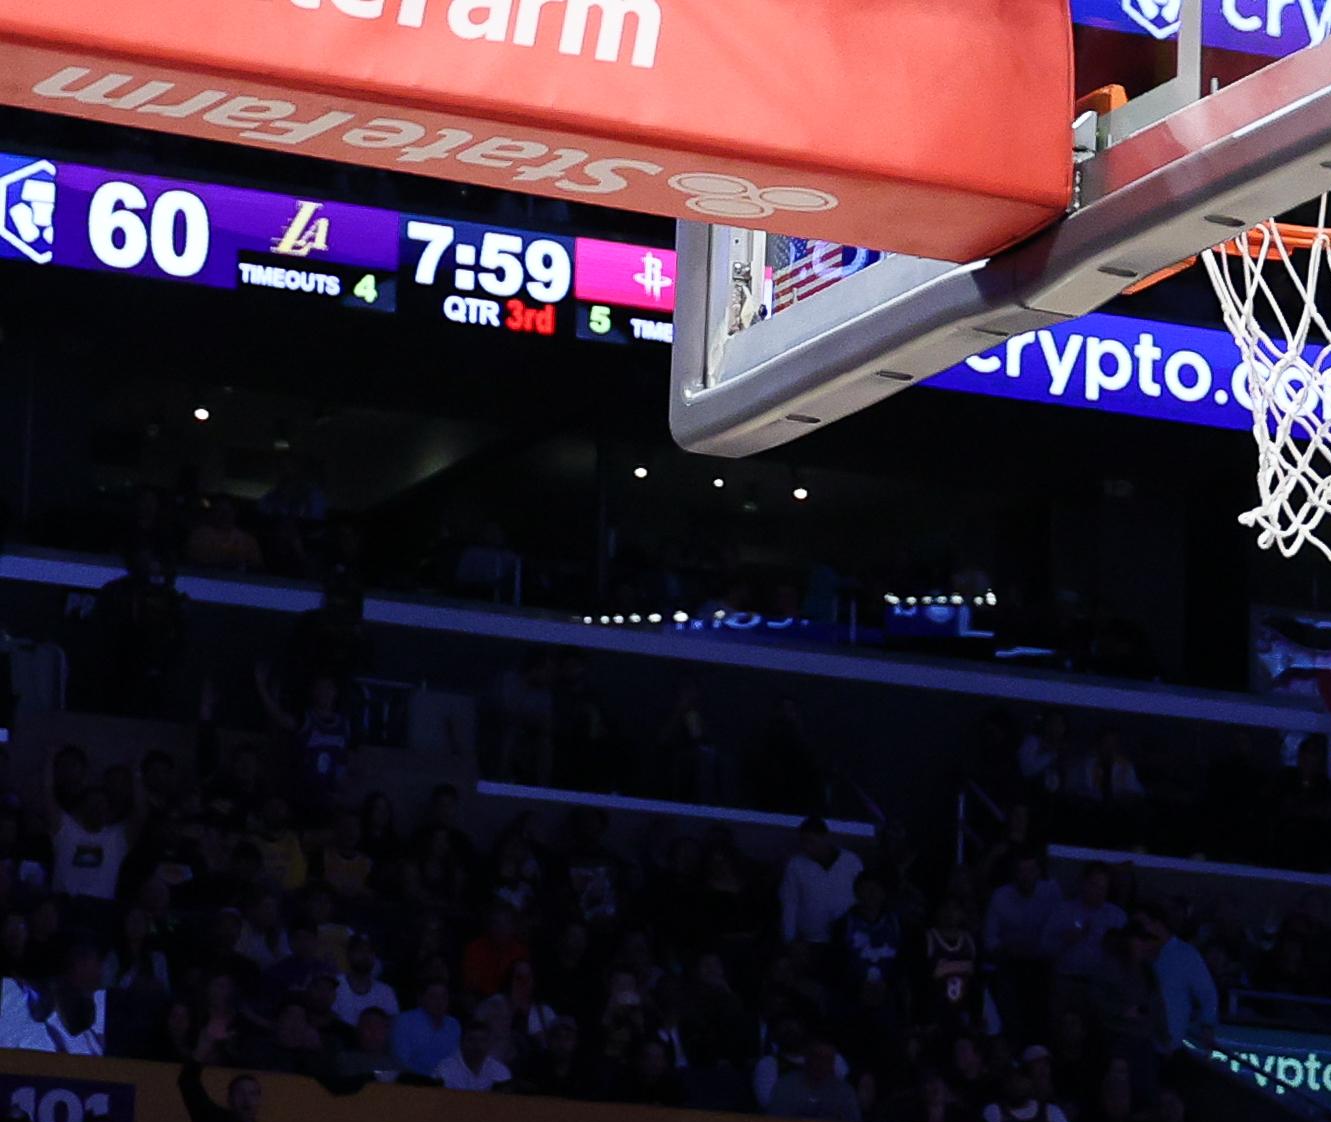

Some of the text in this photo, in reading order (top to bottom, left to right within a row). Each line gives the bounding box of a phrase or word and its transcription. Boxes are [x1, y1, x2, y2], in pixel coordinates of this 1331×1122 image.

[88, 181, 210, 277] 60
[407, 220, 572, 303] 7:59
[238, 262, 378, 304] TIMEOUTS 4
[443, 295, 556, 336] QTR 3rd
[589, 306, 612, 334] 5
